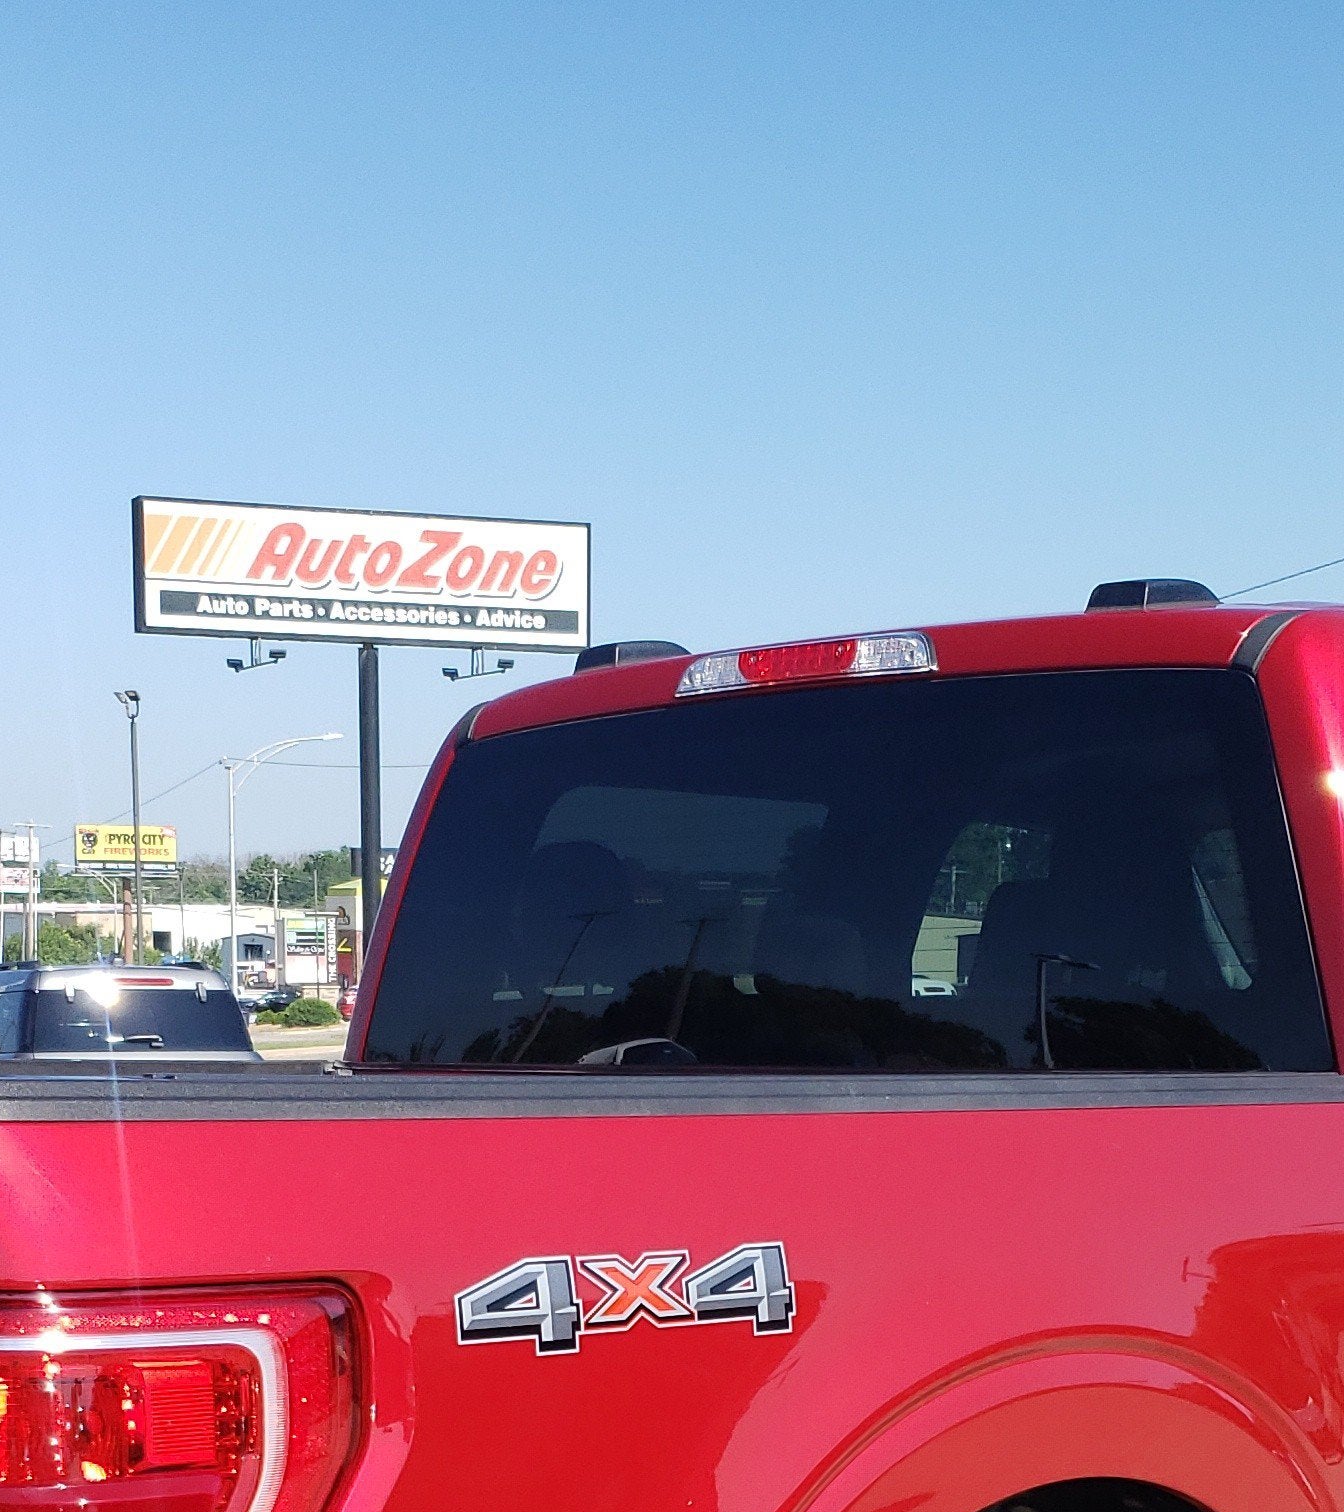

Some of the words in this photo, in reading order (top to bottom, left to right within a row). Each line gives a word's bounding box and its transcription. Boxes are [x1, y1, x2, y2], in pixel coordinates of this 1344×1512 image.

[245, 521, 562, 599] AutoZone
[196, 595, 249, 616] Auto
[255, 598, 314, 619] Parts
[329, 602, 460, 626] Accessories
[476, 609, 546, 630] Advice
[141, 833, 164, 845] CITY
[327, 917, 337, 963] CROSSING
